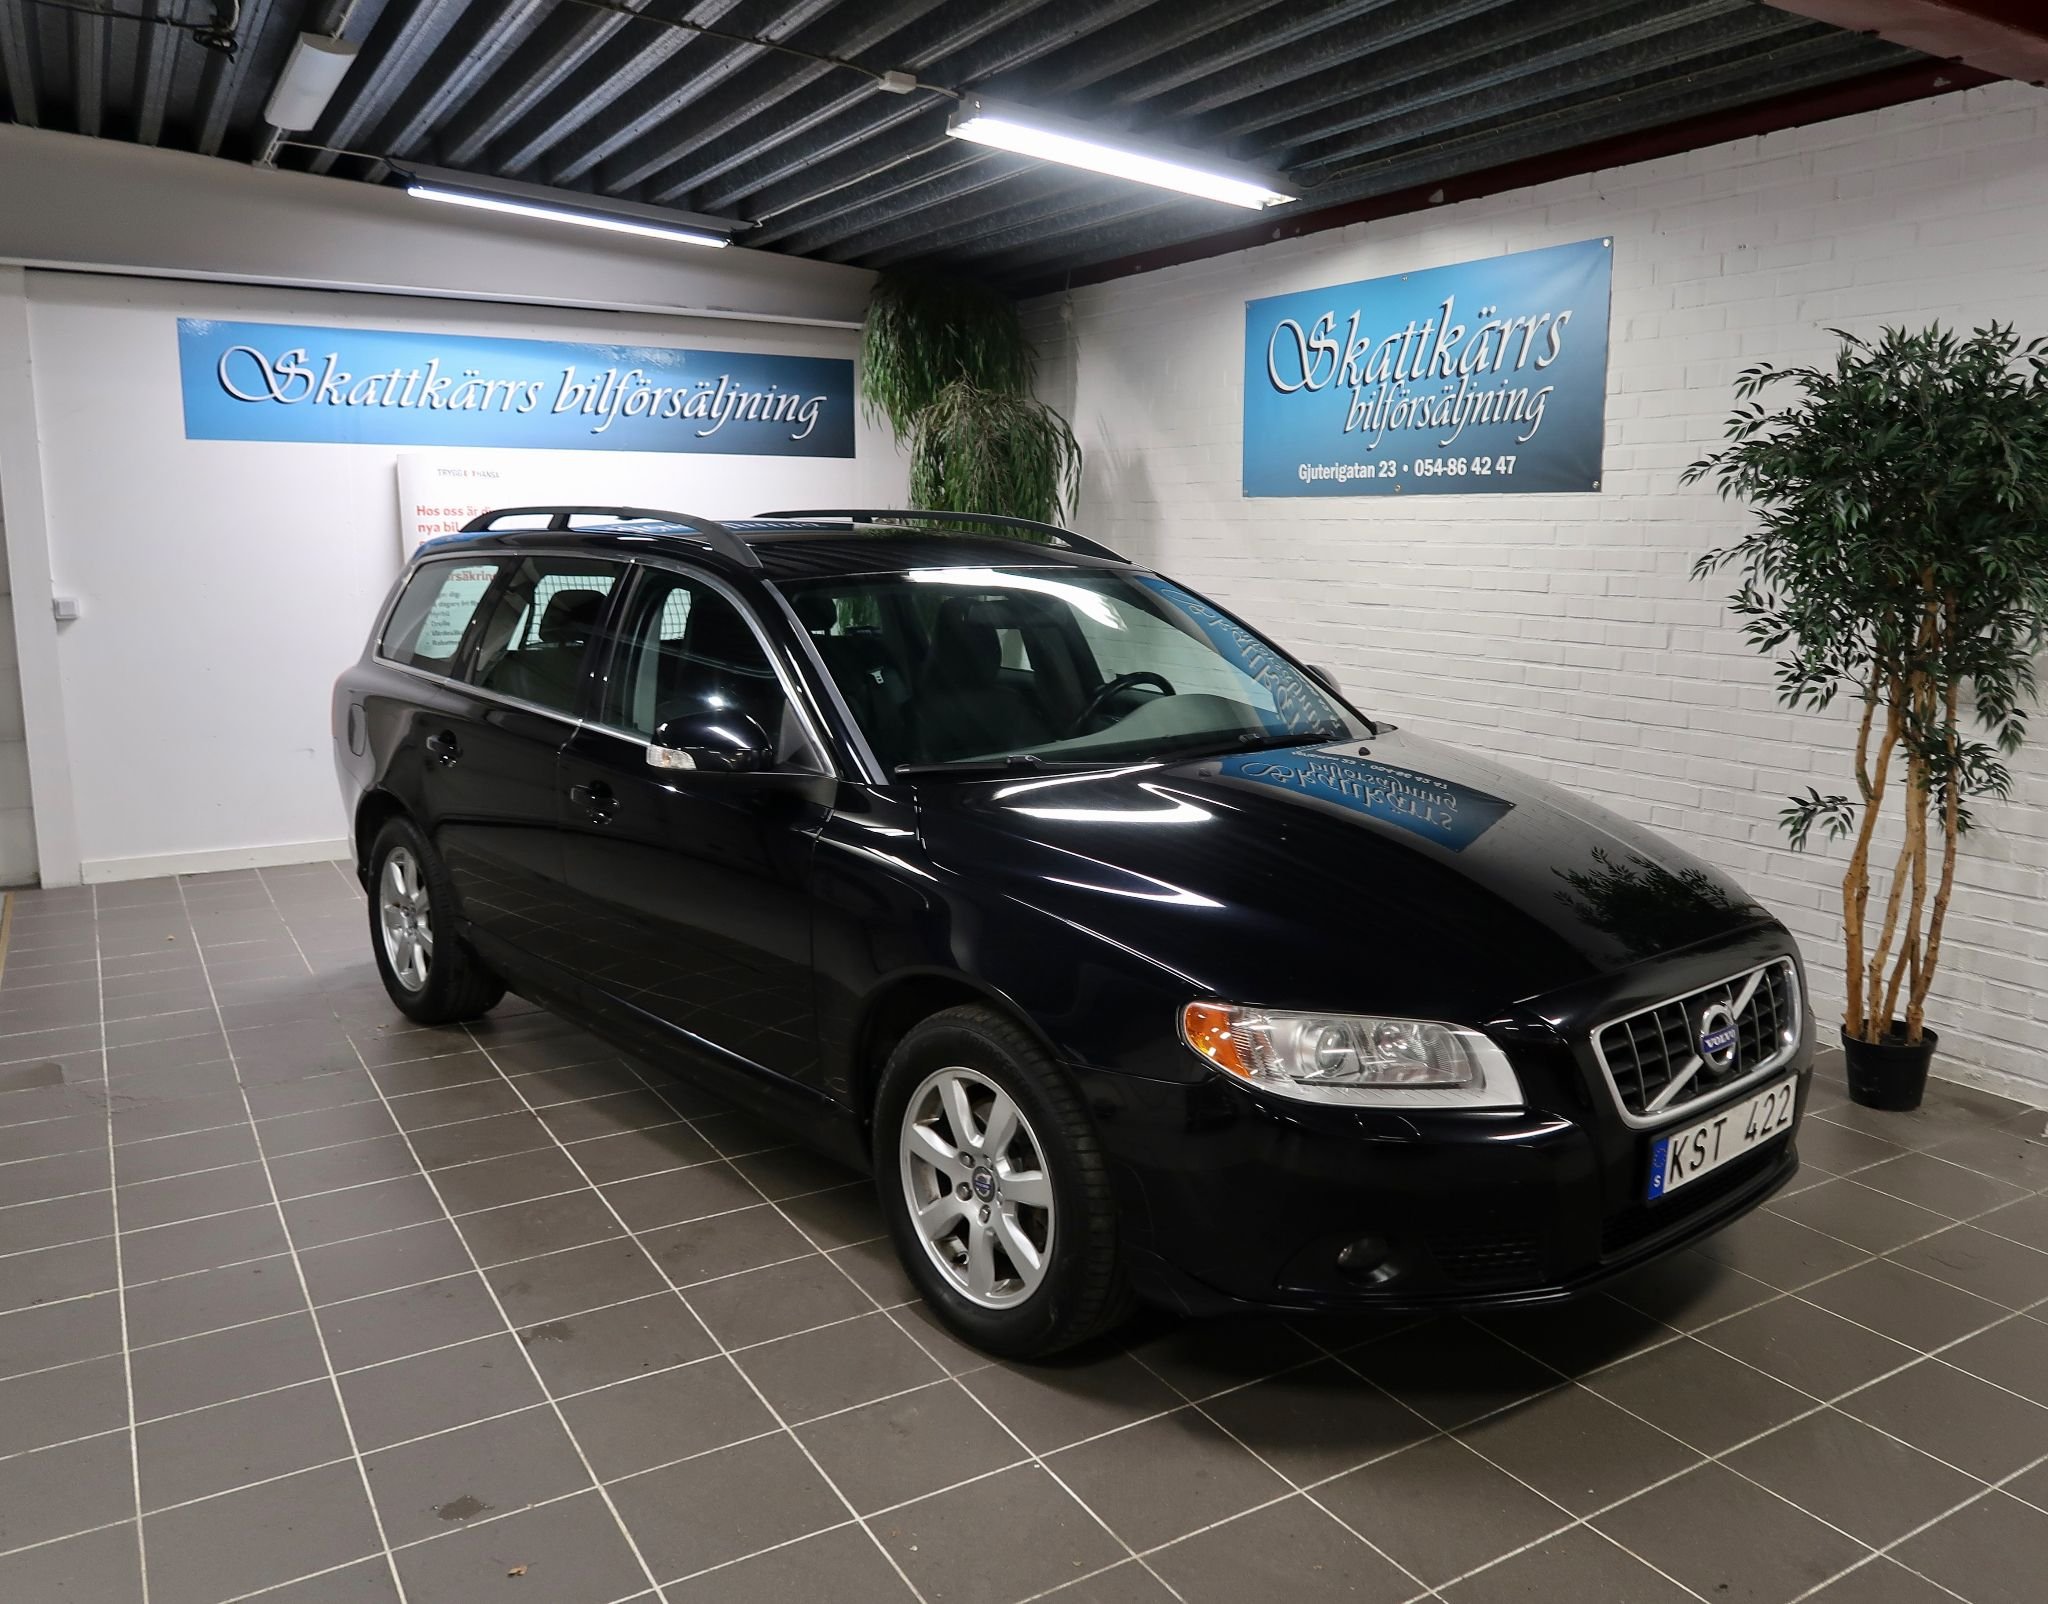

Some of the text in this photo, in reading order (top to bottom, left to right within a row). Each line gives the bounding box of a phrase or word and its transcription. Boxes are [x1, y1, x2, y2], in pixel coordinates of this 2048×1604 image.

[1268, 295, 1574, 392] Skattkärrs
[217, 345, 827, 440] Skattkärrs bilförsäljning
[1342, 374, 1555, 451] bilförsäljning
[1298, 455, 1517, 483] Gjuterigatan 23 054-86 42 47
[416, 505, 440, 516] Hos
[443, 508, 464, 516] oss
[418, 524, 441, 535] nya
[1704, 1029, 1736, 1048] VOLVO
[1668, 1084, 1792, 1184] KST 422
[1653, 1175, 1661, 1188] S
